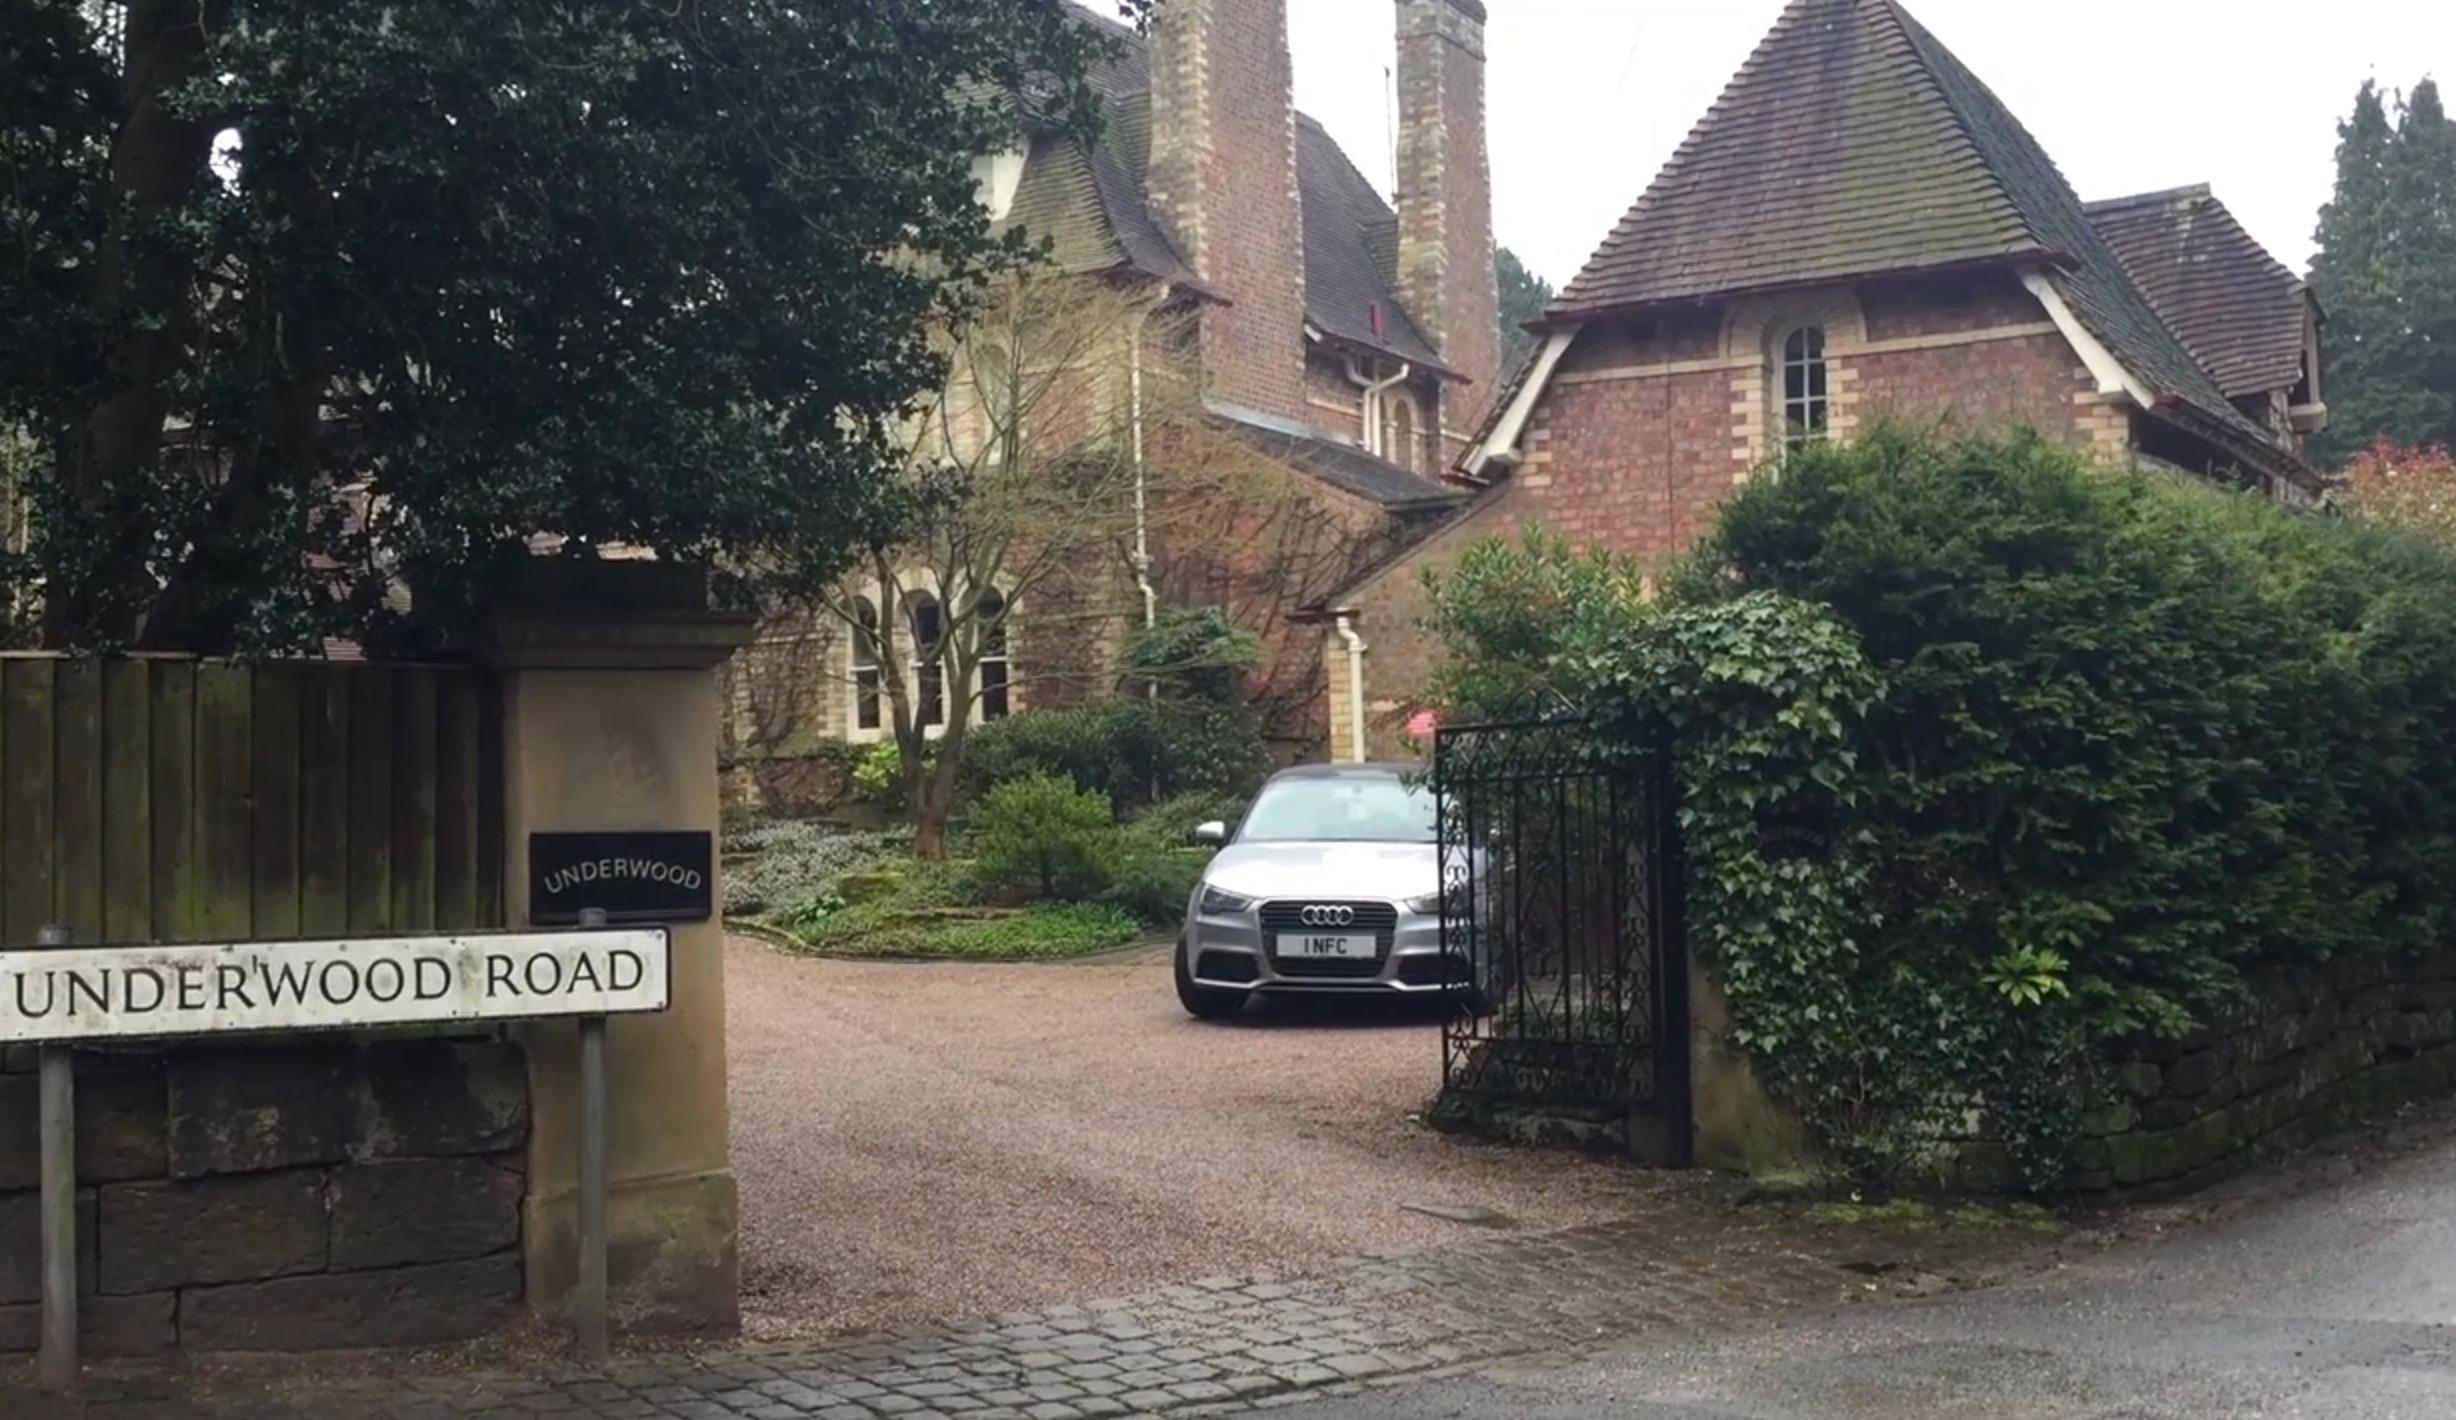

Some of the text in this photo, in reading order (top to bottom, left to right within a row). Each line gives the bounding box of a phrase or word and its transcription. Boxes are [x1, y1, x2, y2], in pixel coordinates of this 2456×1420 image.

[544, 858, 701, 893] UNDERWOOD
[1313, 937, 1348, 954] NFC
[486, 949, 644, 997] ROAD
